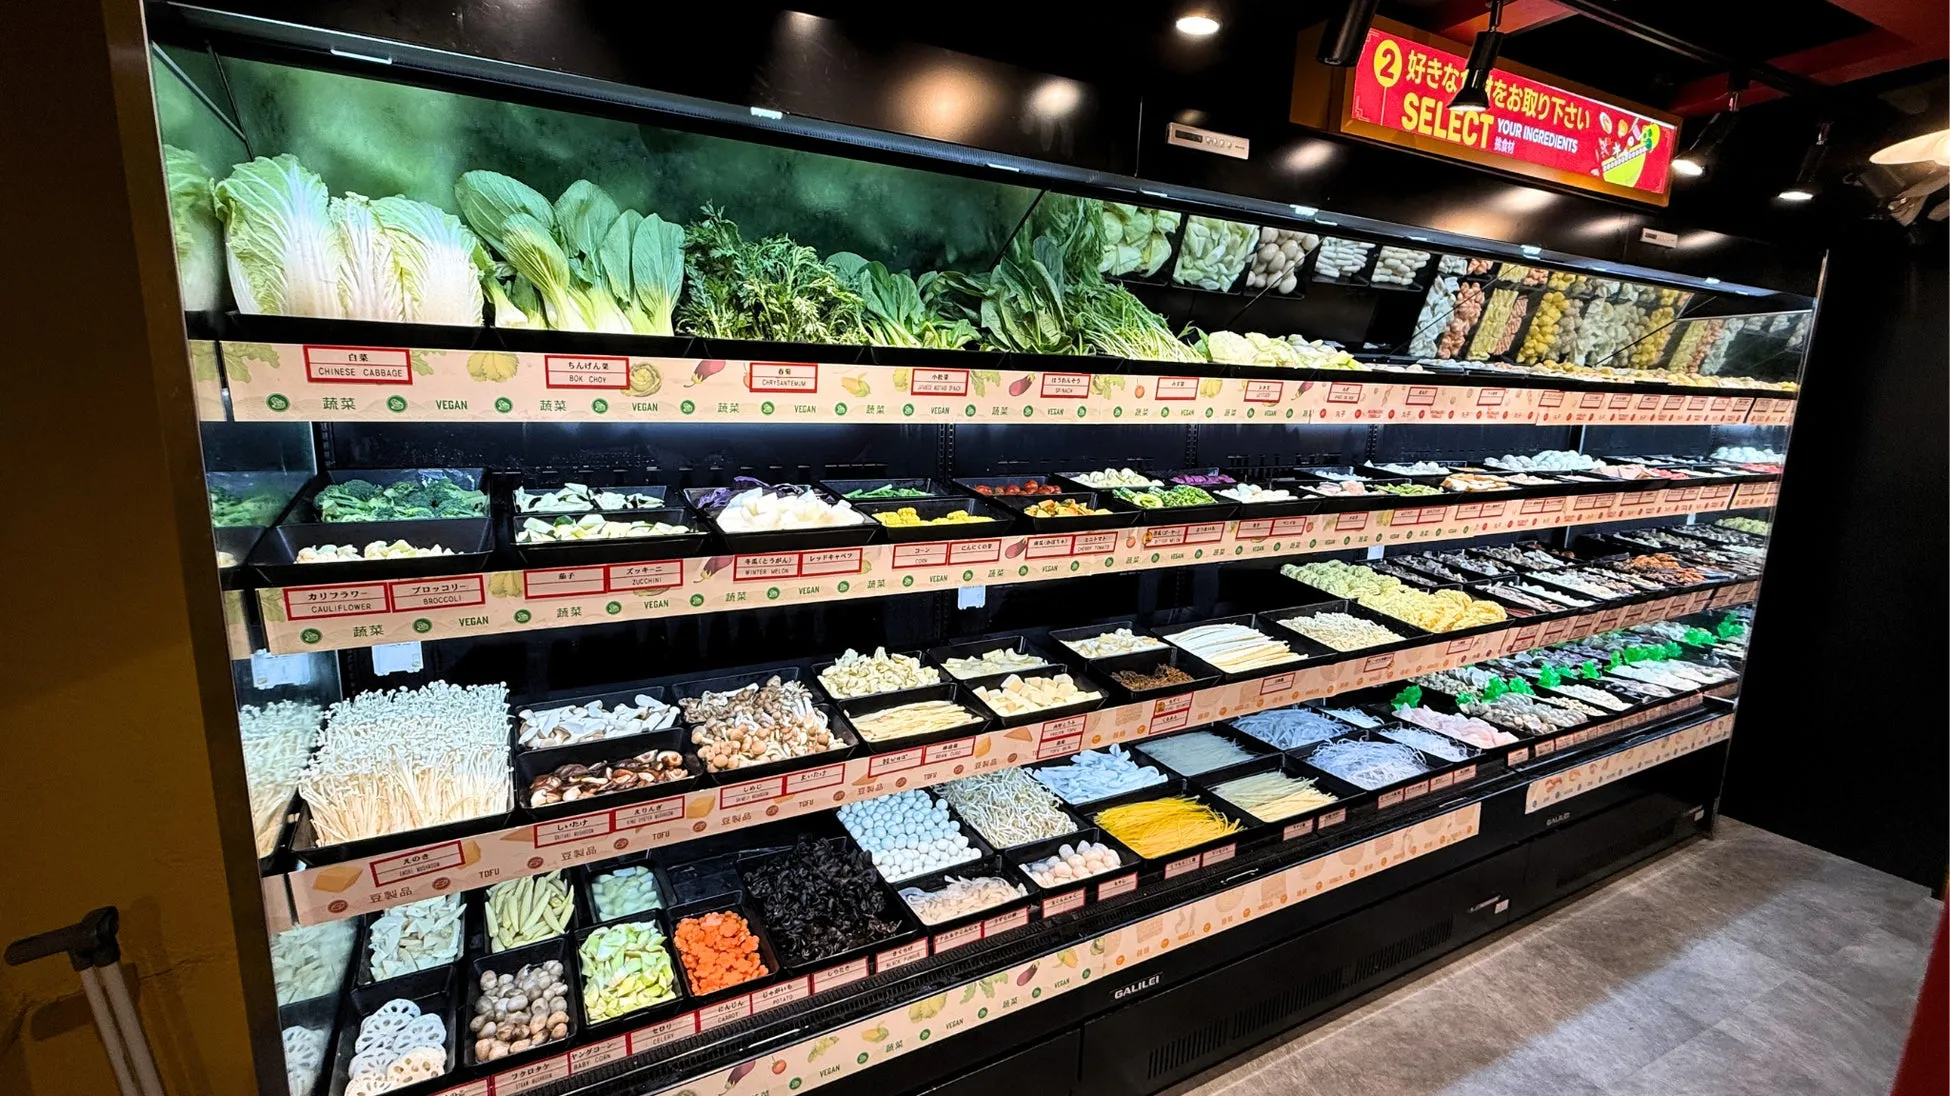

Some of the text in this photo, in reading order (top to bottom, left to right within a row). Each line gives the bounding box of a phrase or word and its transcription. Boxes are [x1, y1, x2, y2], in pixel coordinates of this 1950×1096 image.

[1380, 48, 1590, 130] 2 好きなをお取り下さい
[1401, 92, 1579, 153] SELECT YOUR INGREDIENTS
[348, 353, 369, 362] 白菜
[568, 361, 609, 371] ちんげん菜
[318, 367, 403, 377] CHINESE CABBAGE
[322, 397, 356, 411] 蔬菜
[436, 400, 467, 410] VEGAN
[540, 400, 566, 411] 蔬菜
[632, 402, 658, 411] VEGAN
[717, 403, 740, 414] 蔬菜
[794, 405, 816, 414] VEGAN
[866, 405, 885, 414] 蔬菜
[931, 407, 950, 415] VEGAN
[1048, 408, 1064, 416] VEGAN
[626, 566, 663, 575] ズッキーニ
[745, 567, 789, 576] WINTER MELON
[1041, 565, 1058, 573] VEGAN
[558, 572, 575, 580] 茄子
[632, 577, 662, 585] ZUCCHINI
[930, 575, 948, 583] VEGAN
[412, 583, 466, 594] ブロッコリー
[867, 579, 886, 588] 蔬菜
[308, 589, 367, 600] カリフラワー
[798, 586, 820, 595] VEGAN
[423, 595, 462, 605] BROCCOLI
[726, 592, 747, 602] 蔬菜
[311, 603, 371, 613] CAULIFLOWER
[644, 600, 668, 609] VEGAN
[557, 606, 581, 618] 蔬菜
[459, 616, 489, 627] VEGAN
[353, 624, 384, 637] 蔬菜
[924, 771, 938, 780] TOFU
[743, 784, 762, 793] しめじ
[857, 783, 885, 795] 豆製品
[799, 799, 814, 808] TOFU
[635, 804, 663, 815] えりんぎ
[721, 811, 752, 825] 豆製品
[557, 819, 588, 831] しいたけ
[653, 830, 671, 840] TOFU
[403, 854, 429, 865] えのき
[561, 846, 598, 862] 豆製品
[416, 862, 440, 872] MUSHROOM
[479, 868, 500, 879] TOFU
[370, 886, 413, 903] 豆製品
[1054, 978, 1070, 989] VEGAN
[1114, 975, 1160, 1000] GALILEI
[762, 984, 793, 999] じゃがいも
[718, 1000, 744, 1013] にんじん
[718, 1011, 739, 1023] CARROT
[652, 1023, 672, 1034] セロリ
[946, 1018, 964, 1030] VEGAN
[653, 1033, 675, 1045] CELERY
[571, 1041, 614, 1060] ヤングコーン
[574, 1053, 611, 1070] BABY CORN
[511, 1063, 551, 1080] フクロタケ
[820, 1065, 841, 1078] VEGAN
